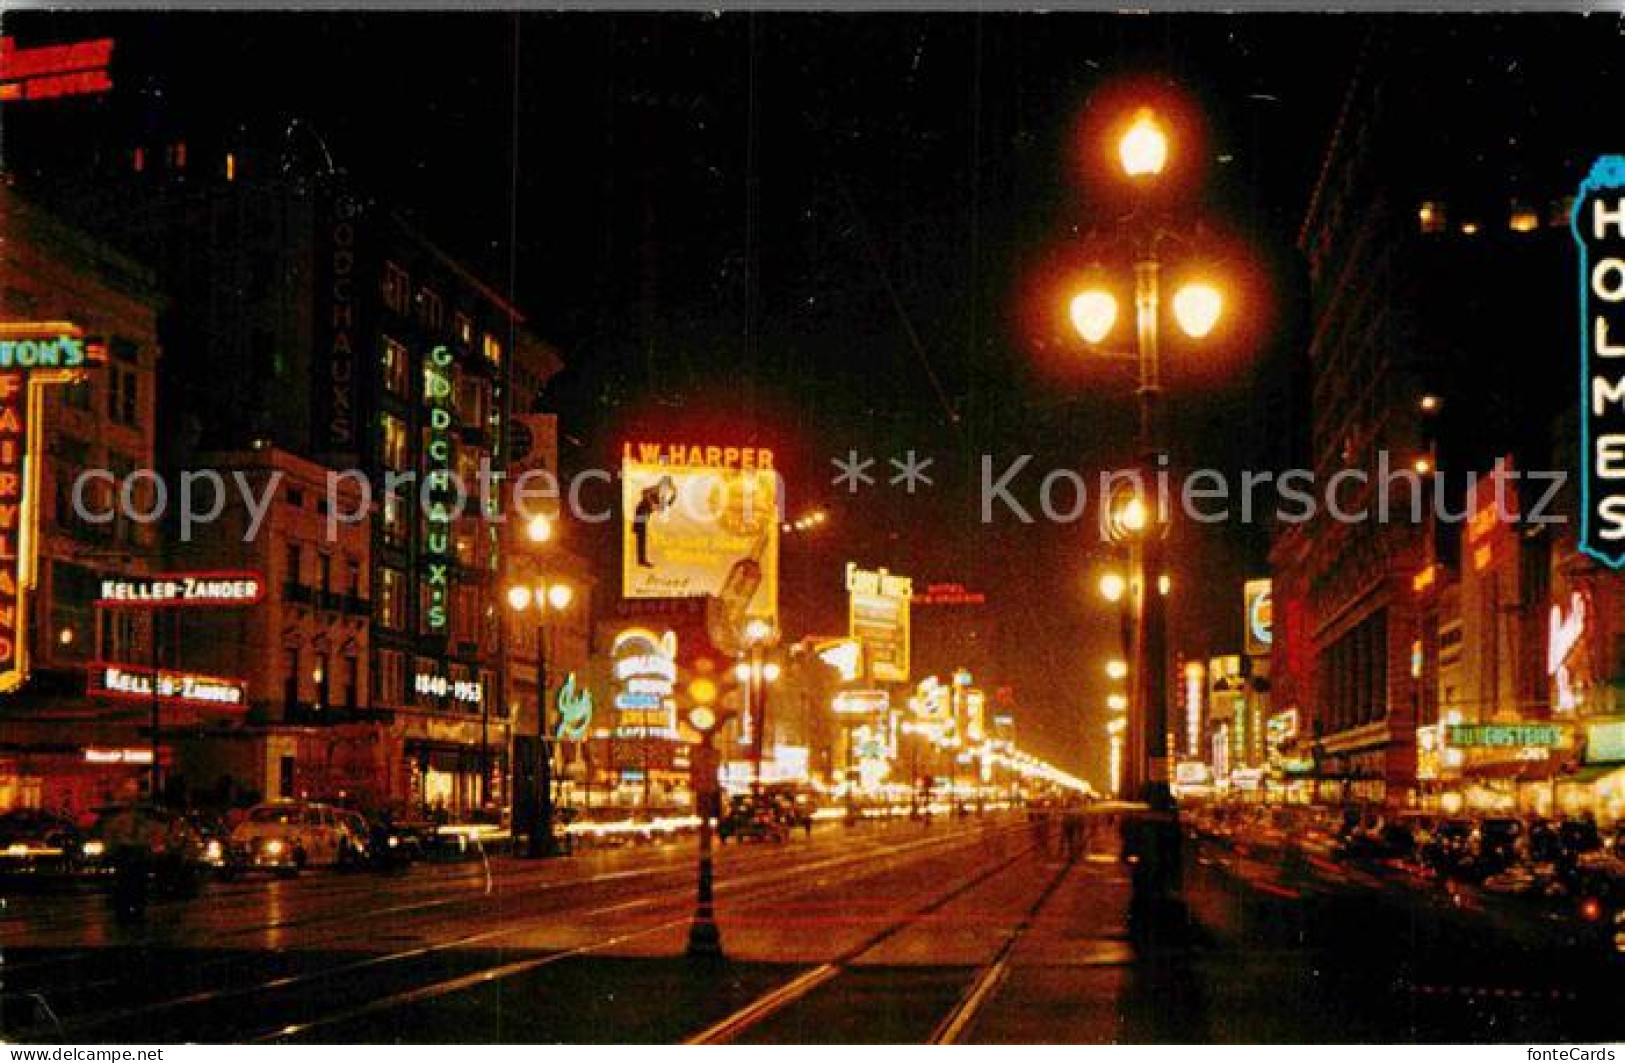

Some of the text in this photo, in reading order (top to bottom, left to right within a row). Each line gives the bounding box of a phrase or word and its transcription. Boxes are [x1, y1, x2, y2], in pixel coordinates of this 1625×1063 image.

[1592, 197, 1625, 541] HOLMES
[670, 443, 774, 470] HARPER
[101, 577, 259, 600] KELLER-ZANDER
